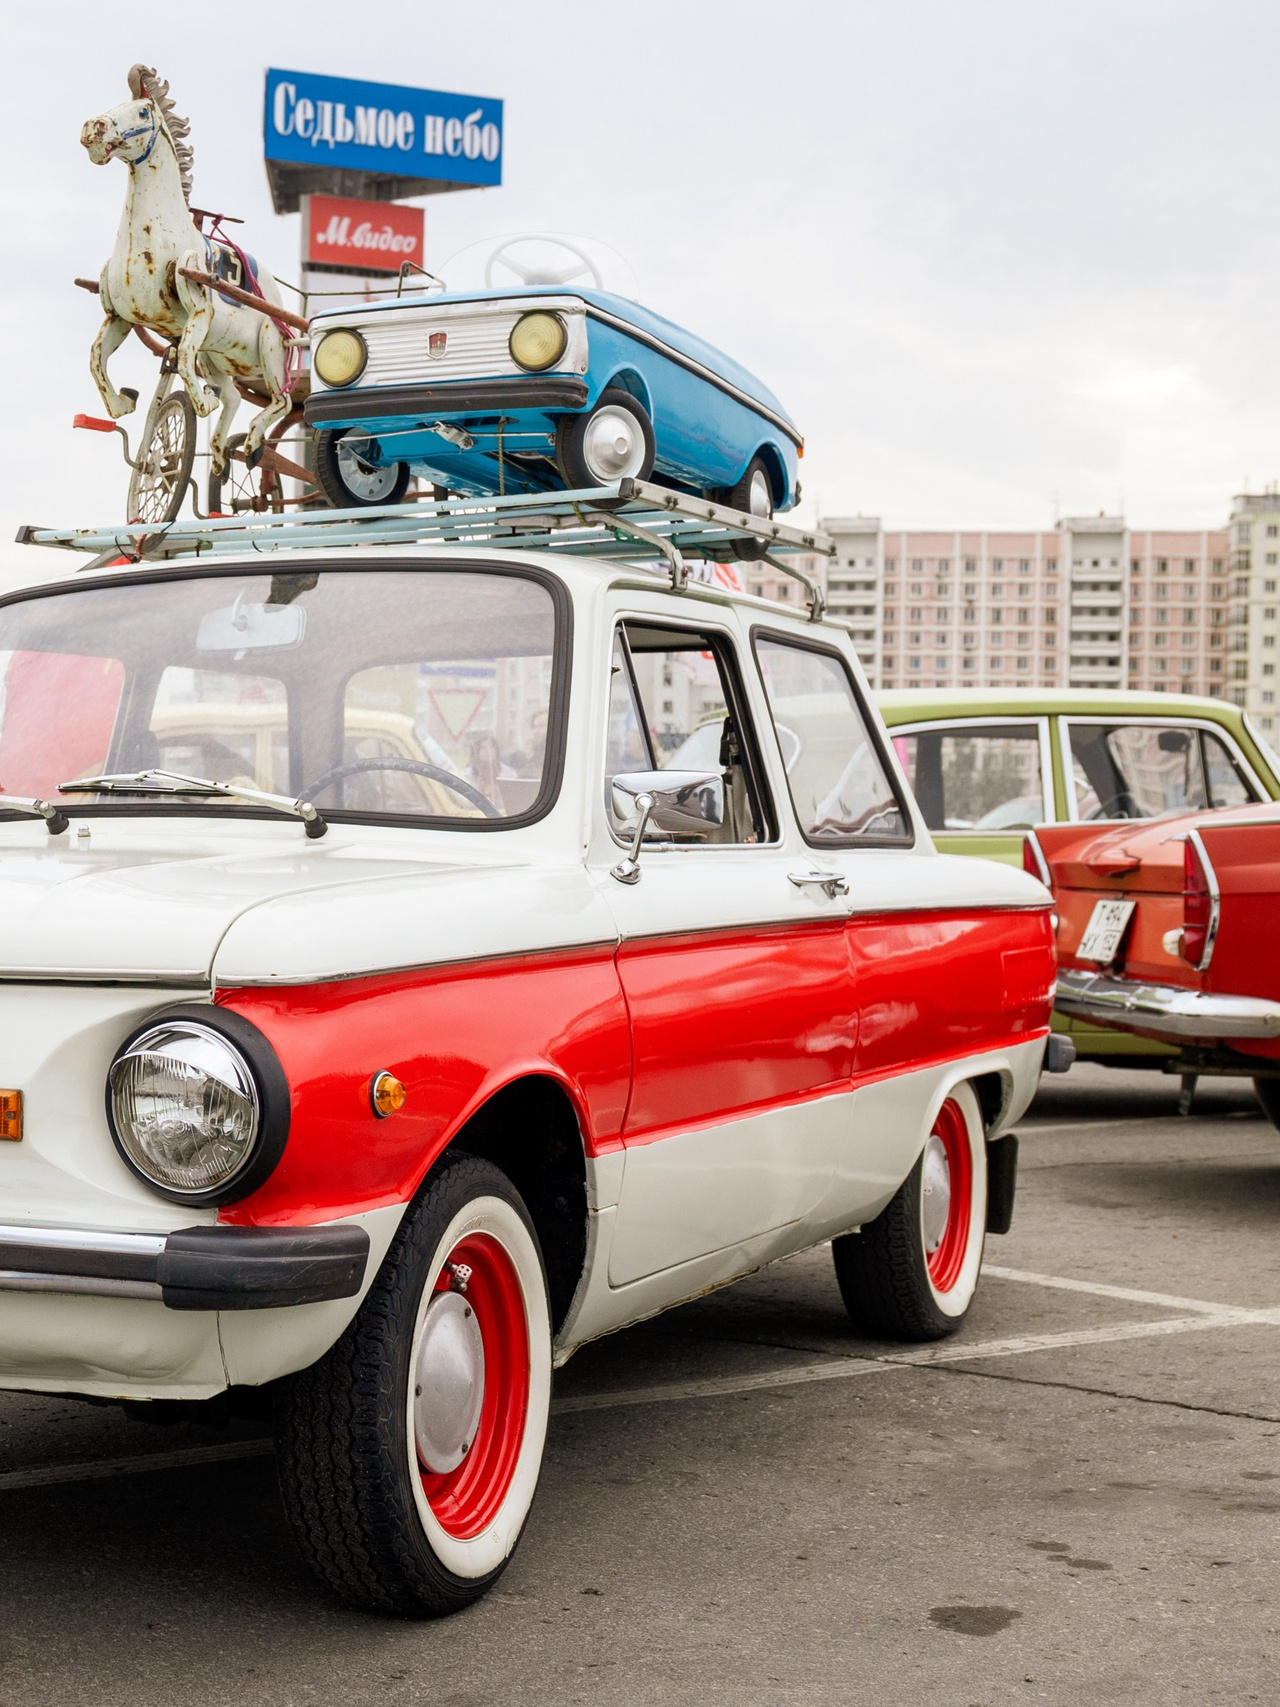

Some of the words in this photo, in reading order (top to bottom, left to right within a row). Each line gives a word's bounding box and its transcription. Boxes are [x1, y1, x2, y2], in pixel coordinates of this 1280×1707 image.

[273, 81, 415, 150] Седьмое
[424, 108, 500, 162] небо
[316, 215, 417, 254] М.видео
